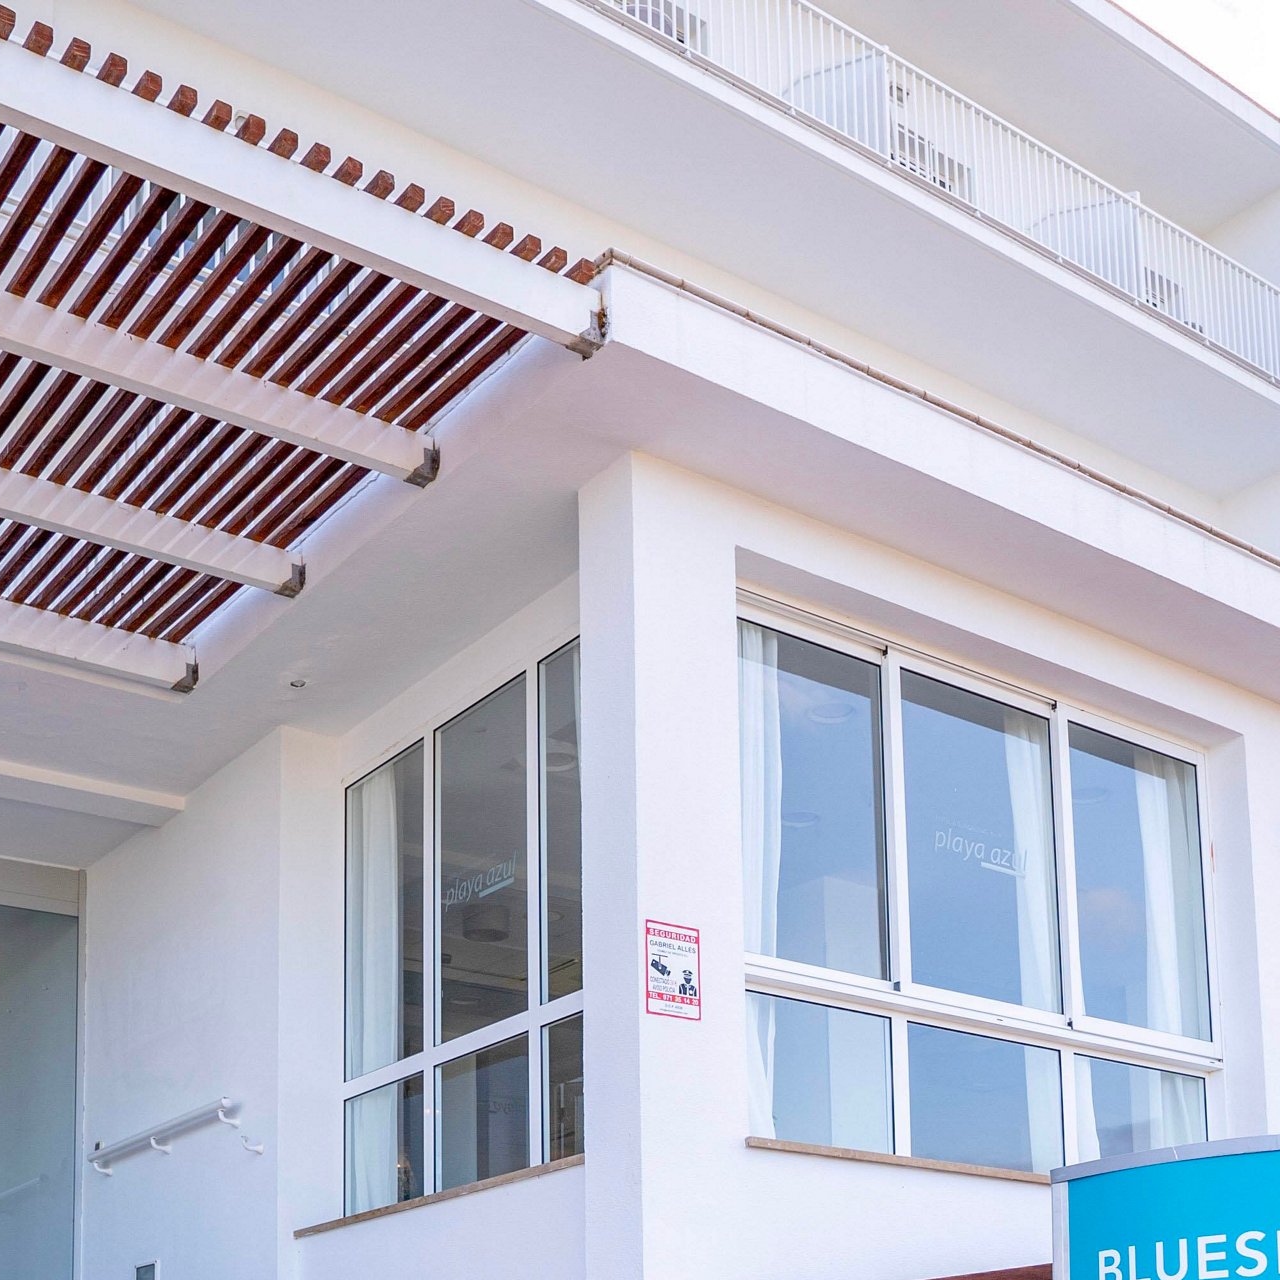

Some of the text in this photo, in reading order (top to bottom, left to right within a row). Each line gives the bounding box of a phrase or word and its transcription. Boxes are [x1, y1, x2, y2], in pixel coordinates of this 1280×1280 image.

[934, 828, 1028, 874] playa azul
[446, 848, 517, 913] playa azul
[649, 928, 696, 943] SEGURIDAD
[649, 940, 676, 950] GABRIEL
